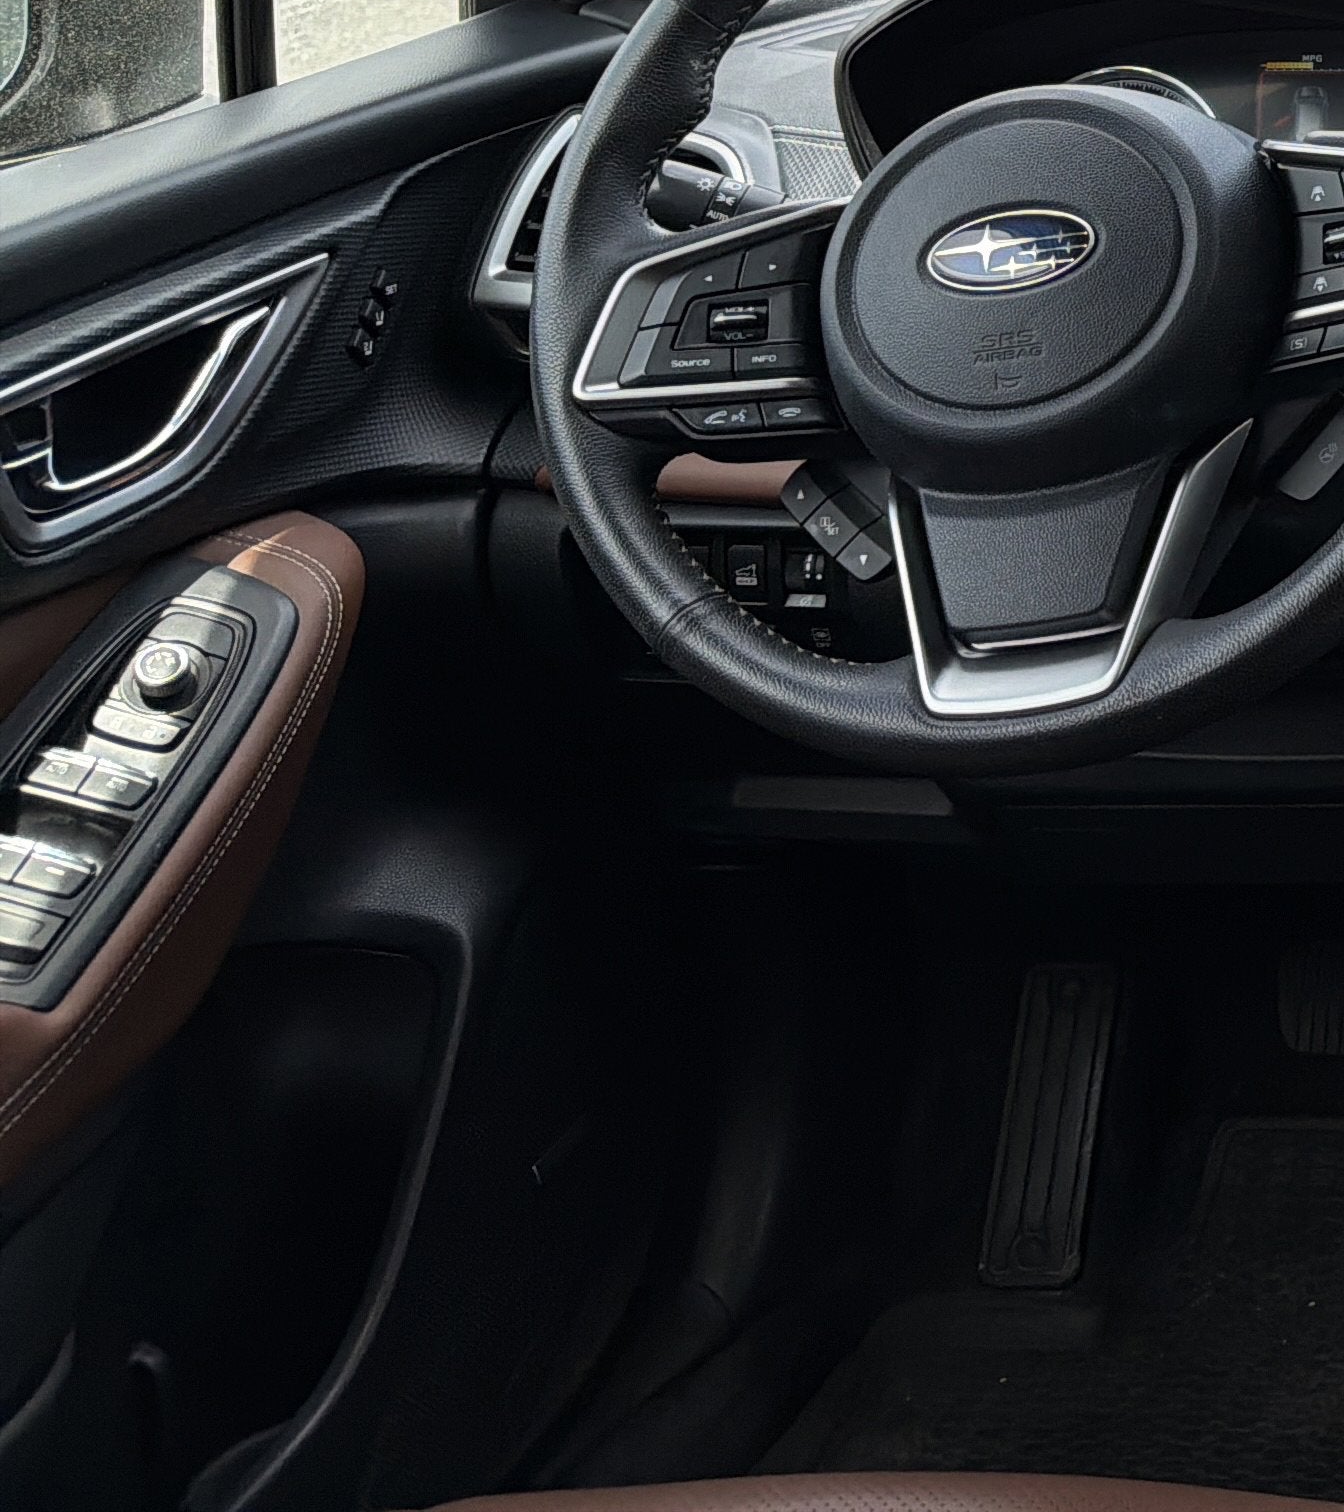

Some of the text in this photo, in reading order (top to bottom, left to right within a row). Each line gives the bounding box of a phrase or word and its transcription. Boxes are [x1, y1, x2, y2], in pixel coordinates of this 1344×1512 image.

[1302, 54, 1323, 63] MPG
[982, 329, 1033, 348] SRS
[751, 354, 777, 363] INFO
[972, 346, 1044, 365] AIRBAG
[671, 357, 711, 368] Source
